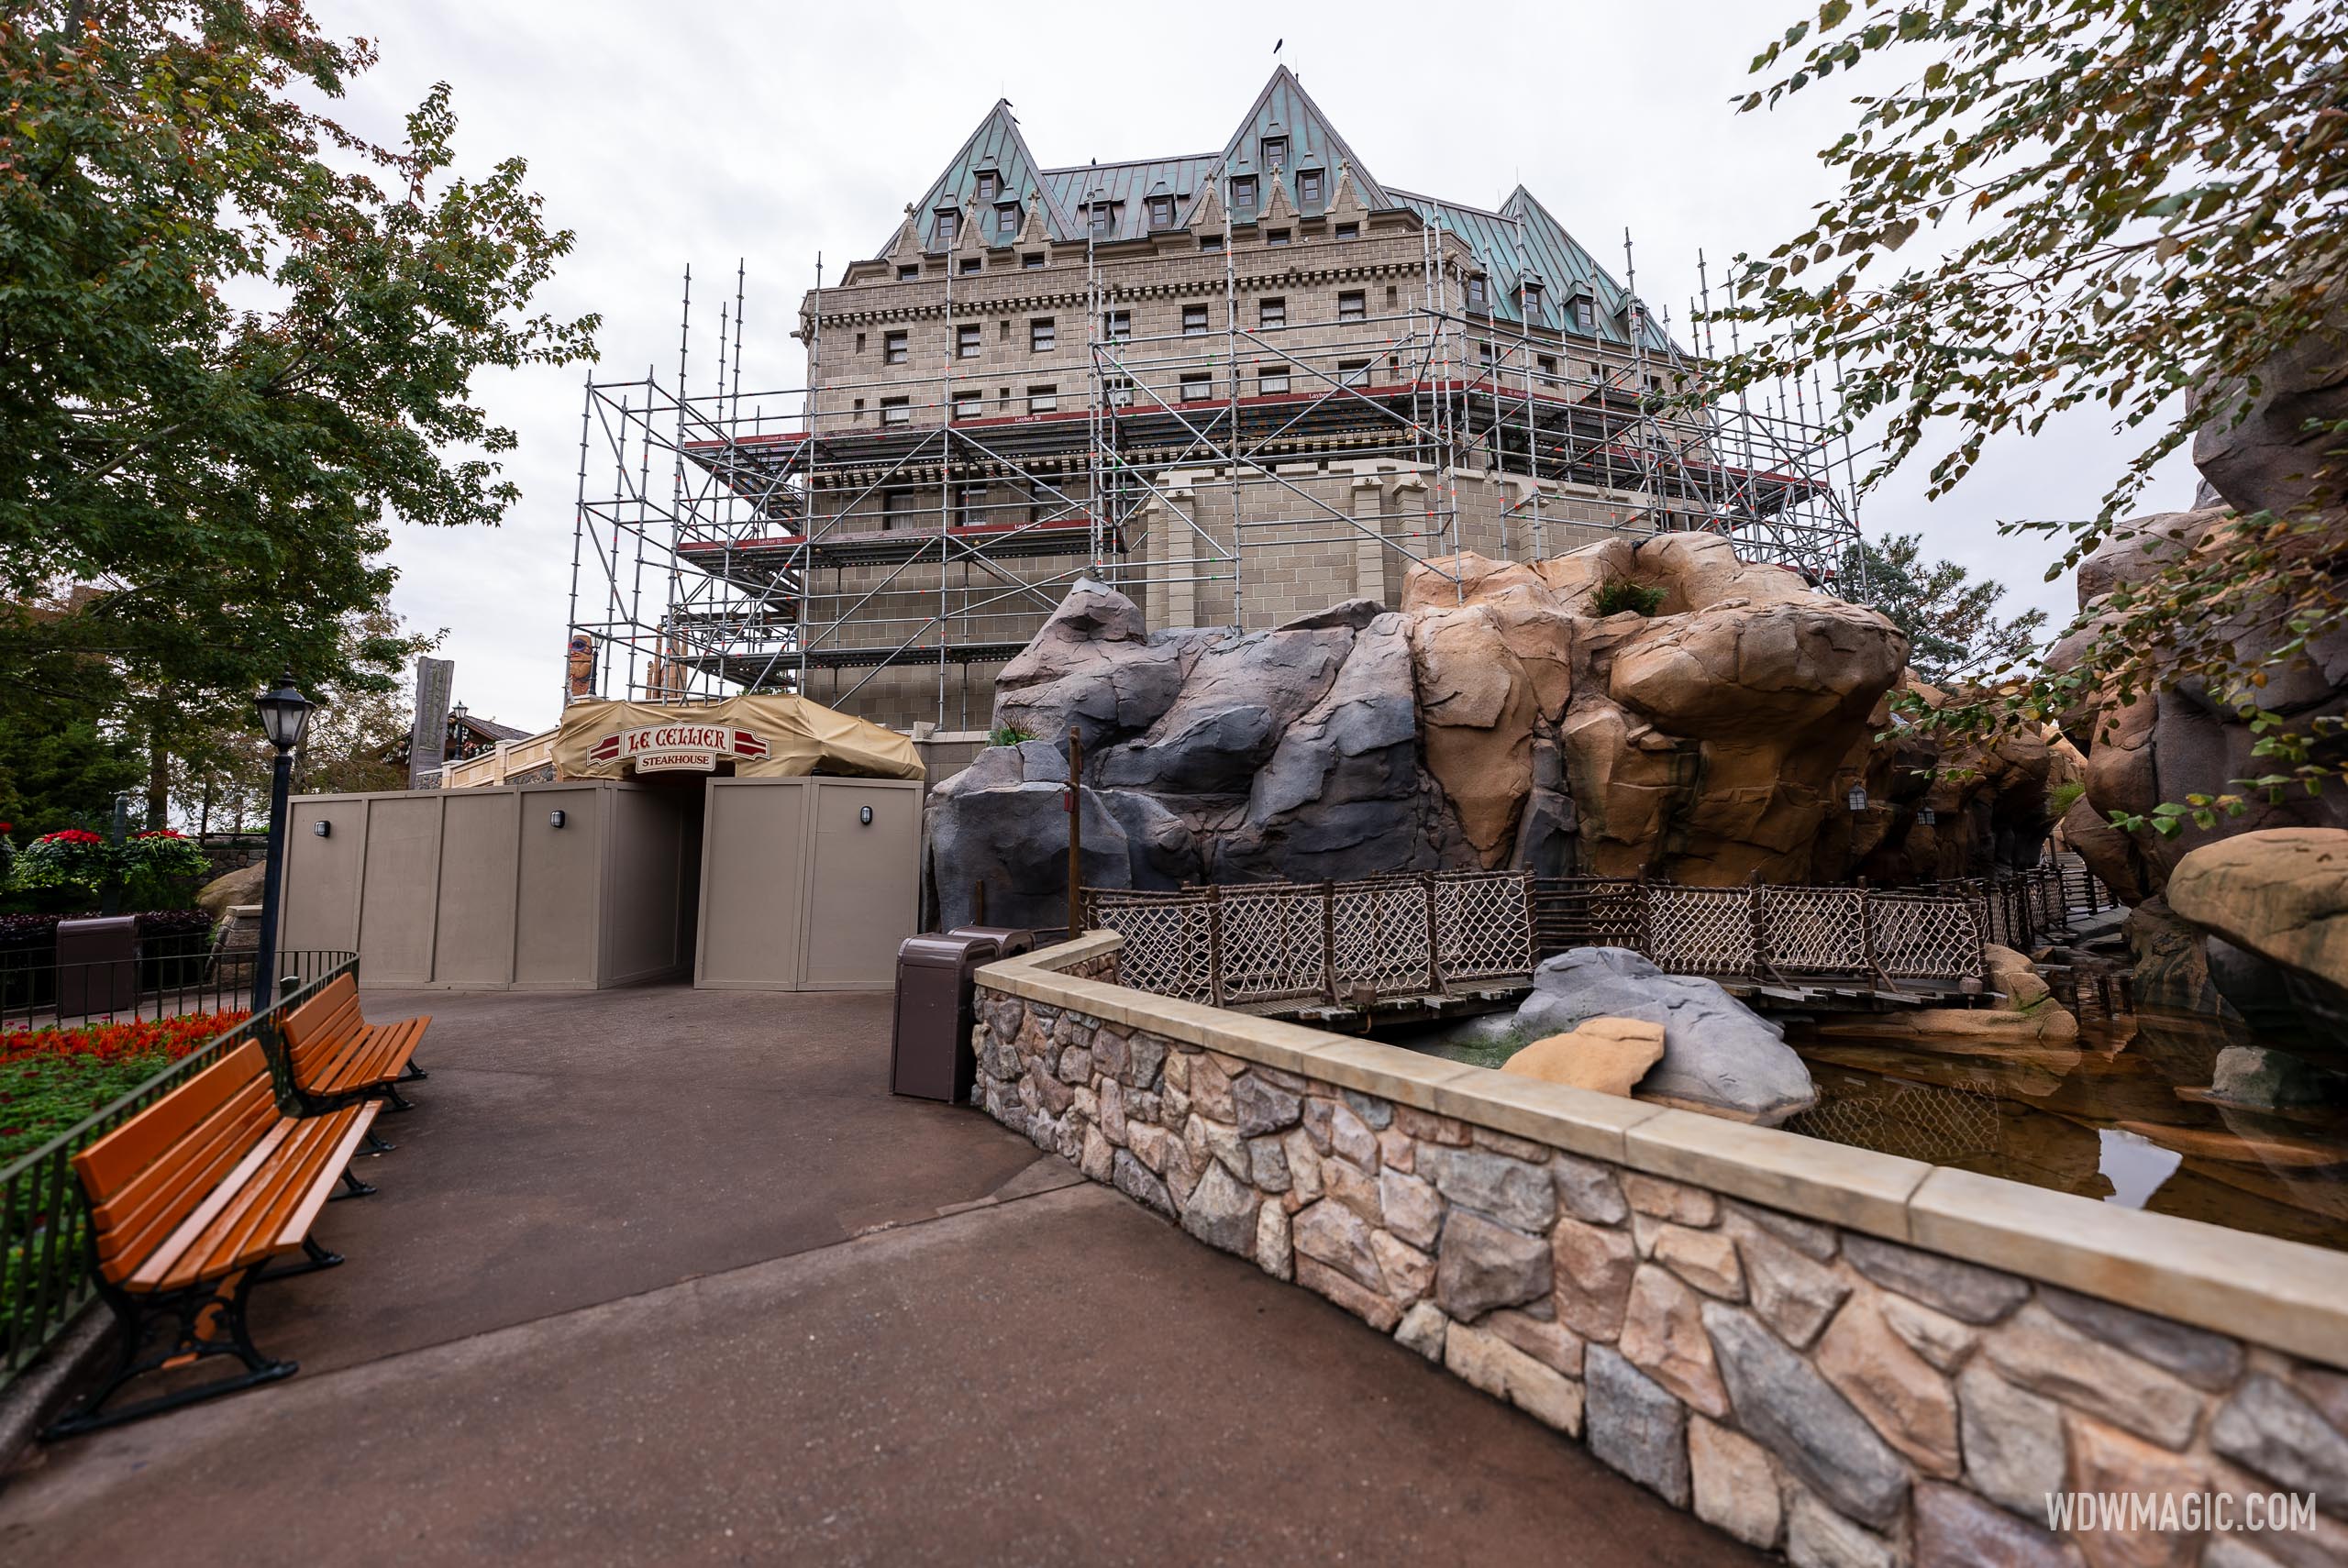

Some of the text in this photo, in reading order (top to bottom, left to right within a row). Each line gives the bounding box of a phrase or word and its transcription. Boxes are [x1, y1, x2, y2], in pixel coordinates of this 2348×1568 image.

[628, 726, 726, 753] LE CELLIER
[642, 755, 710, 767] STEAKHOUSE
